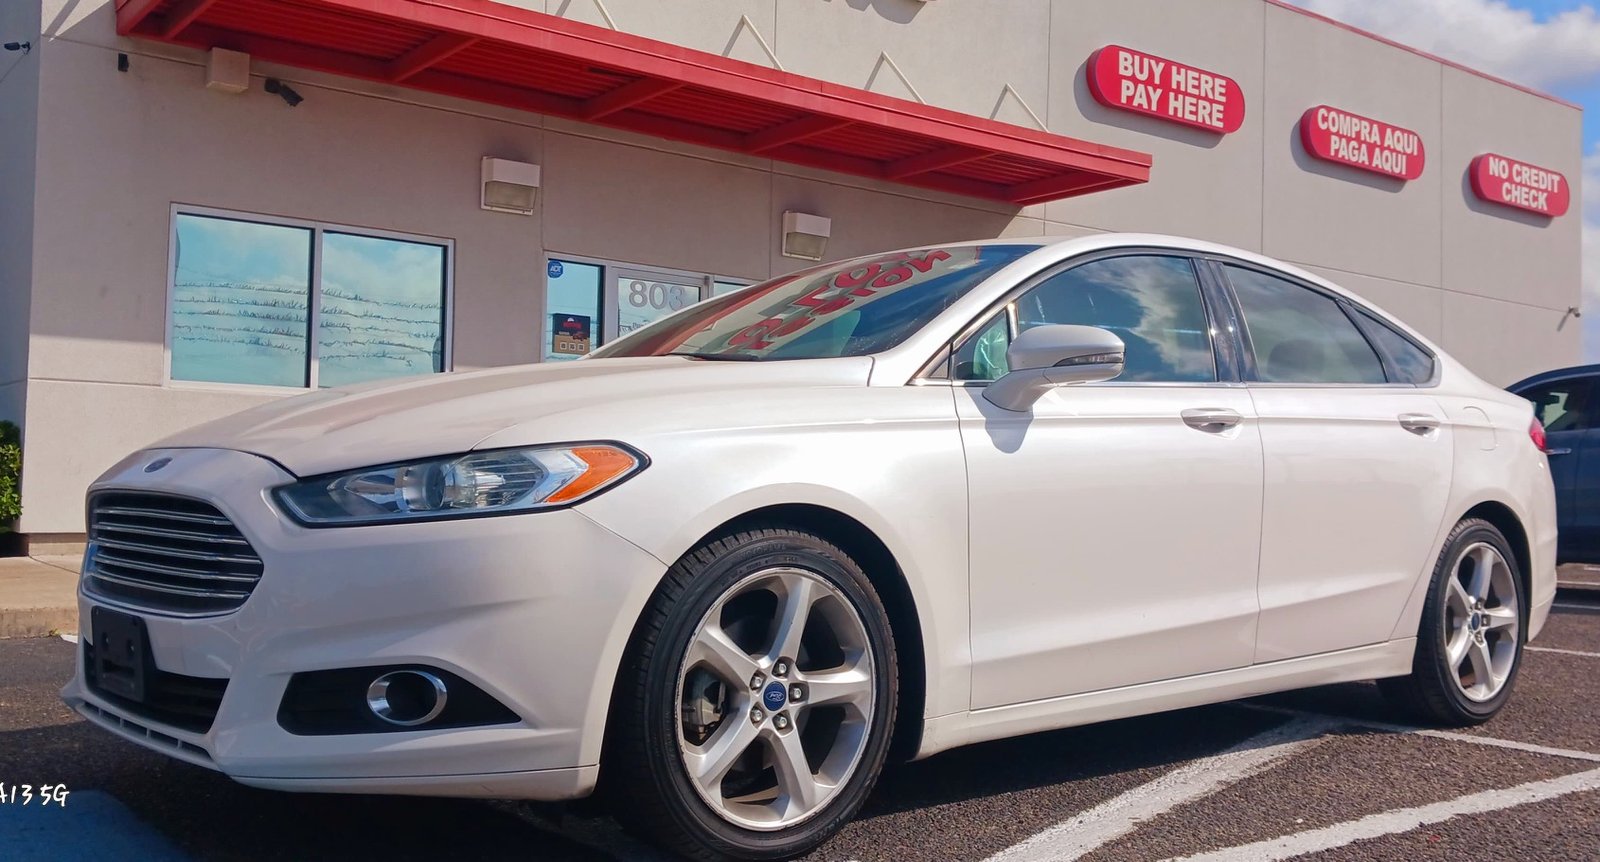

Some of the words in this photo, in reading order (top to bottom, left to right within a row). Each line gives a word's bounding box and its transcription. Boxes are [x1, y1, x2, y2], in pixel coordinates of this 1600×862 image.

[1118, 50, 1165, 85] BUY
[1171, 65, 1226, 103] HERE
[1120, 79, 1163, 112] PAY
[1168, 91, 1224, 128] HERE
[1317, 108, 1381, 146] COMPRA
[1384, 127, 1418, 156] AQUI
[1330, 135, 1369, 166] PAGA
[1372, 147, 1407, 175] AQUI
[1488, 156, 1509, 179] NO
[1512, 164, 1560, 193] CREDIT
[1502, 182, 1548, 211] CHECK
[629, 280, 687, 312] 803
